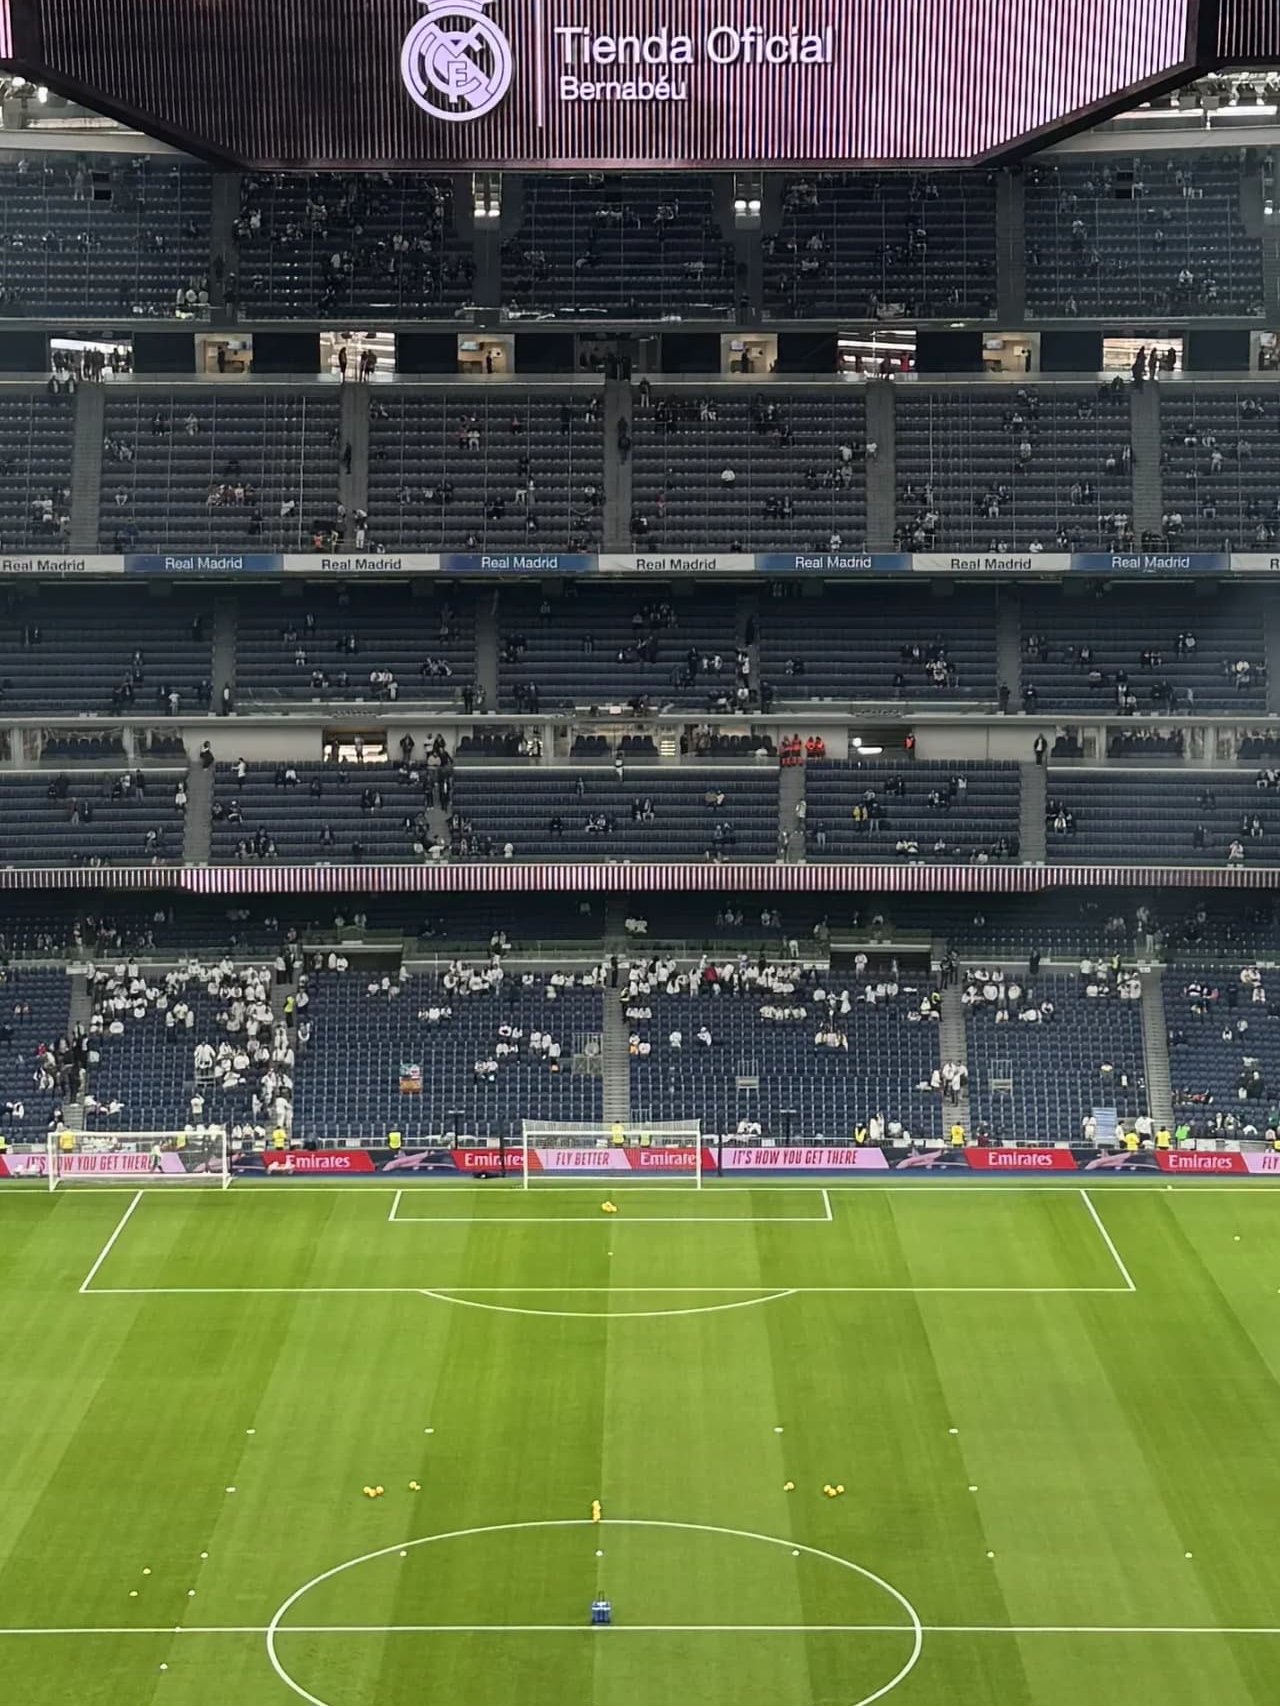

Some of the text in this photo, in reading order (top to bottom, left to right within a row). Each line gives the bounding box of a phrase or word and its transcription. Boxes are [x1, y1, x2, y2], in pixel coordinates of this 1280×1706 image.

[555, 24, 833, 65] Tienda Oficial
[561, 74, 686, 101] Bernabéu
[2, 558, 85, 572] Real Madrid
[165, 556, 243, 570] Real Madrid
[322, 557, 402, 571] Real Madrid
[481, 555, 558, 570] Real Madrid
[636, 557, 717, 571] Real Madrid
[795, 555, 872, 569] Real Madrid
[951, 557, 1032, 571] Real Madrid
[1111, 555, 1190, 569] Real Madrid
[78, 1155, 97, 1171] YOU
[99, 1155, 119, 1171] GET
[285, 1153, 351, 1169] Emirates
[555, 1152, 610, 1166] FLY BETTER
[732, 1150, 858, 1166] IT'S HOW YOU GET THERE
[987, 1151, 1053, 1167] Emirates
[1168, 1154, 1233, 1170] Emirates
[1262, 1156, 1279, 1170] FLY
